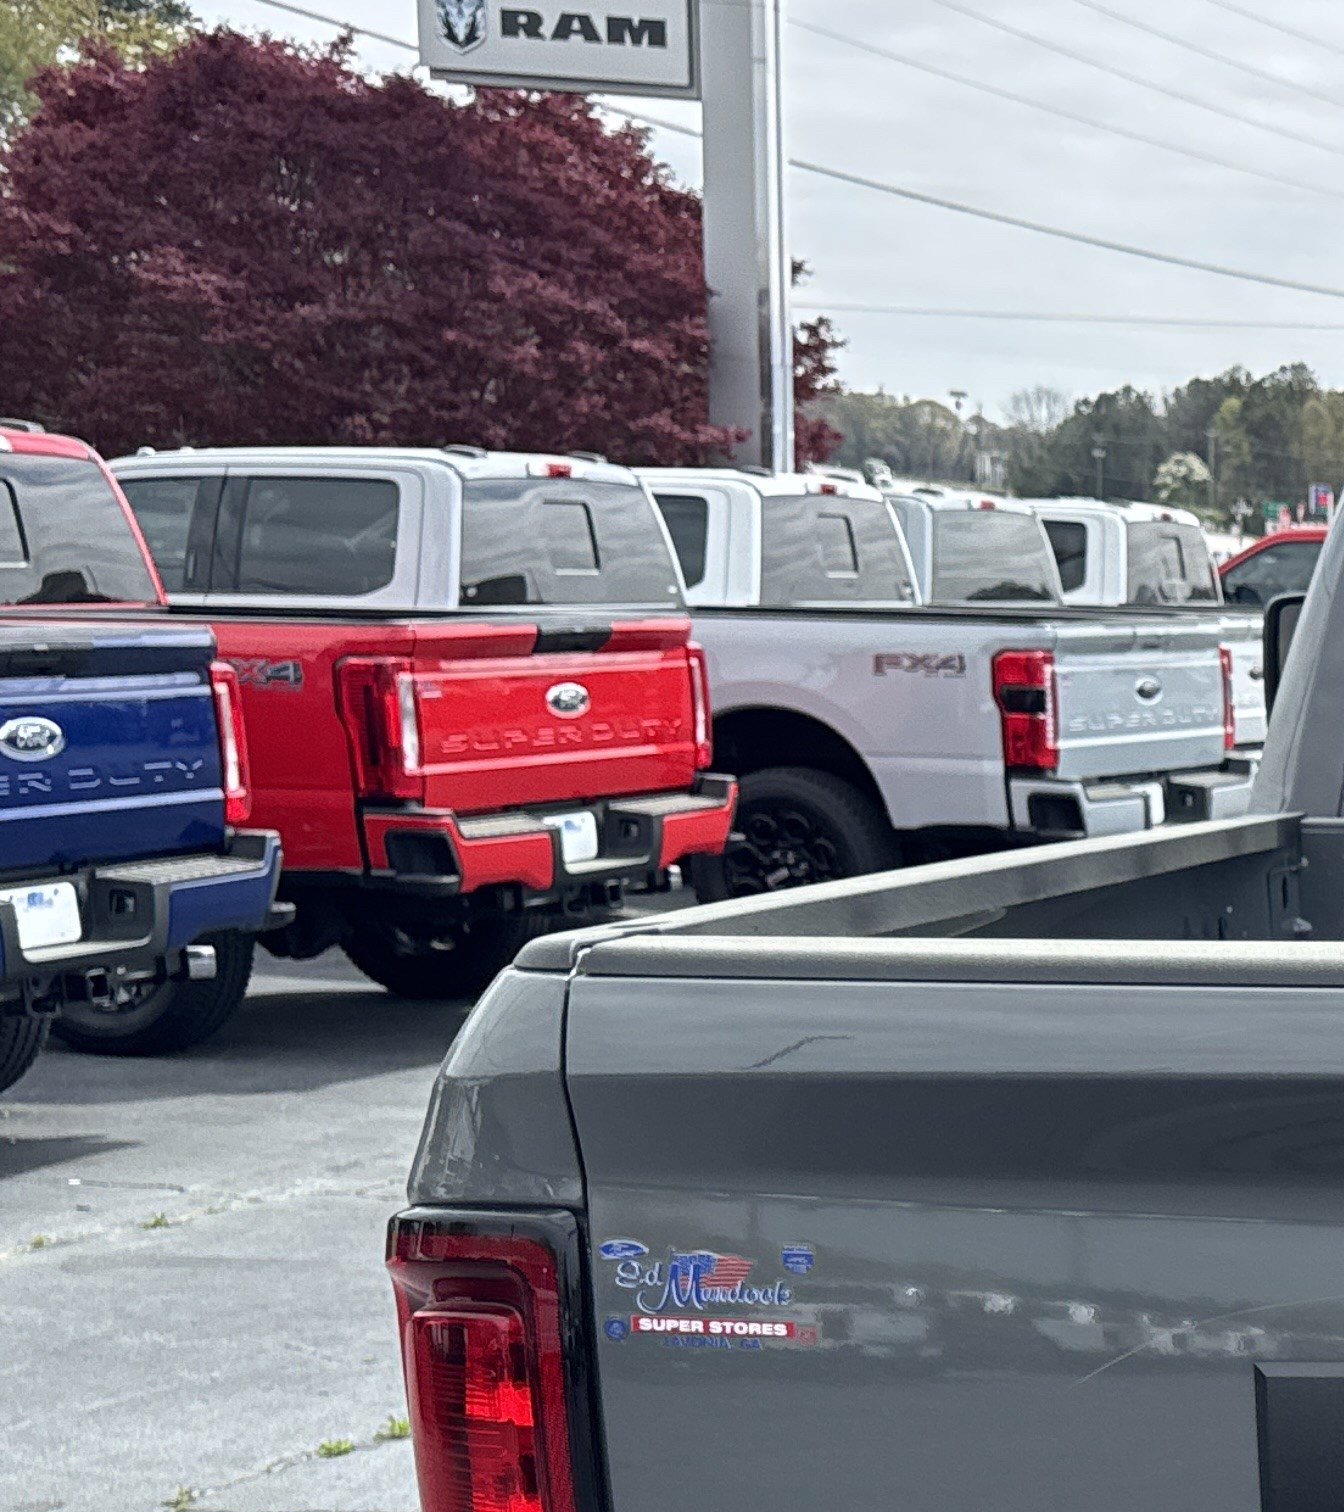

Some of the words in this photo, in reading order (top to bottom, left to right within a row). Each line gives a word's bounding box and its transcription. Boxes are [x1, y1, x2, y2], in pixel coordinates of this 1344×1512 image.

[501, 9, 667, 48] RAM
[873, 652, 967, 676] FX4
[441, 726, 583, 754] SUPER
[591, 718, 682, 741] DUTY
[67, 759, 203, 789] DUTY
[614, 1258, 663, 1289] Ed
[638, 1317, 704, 1333] SUPER
[709, 1321, 788, 1336] STORES
